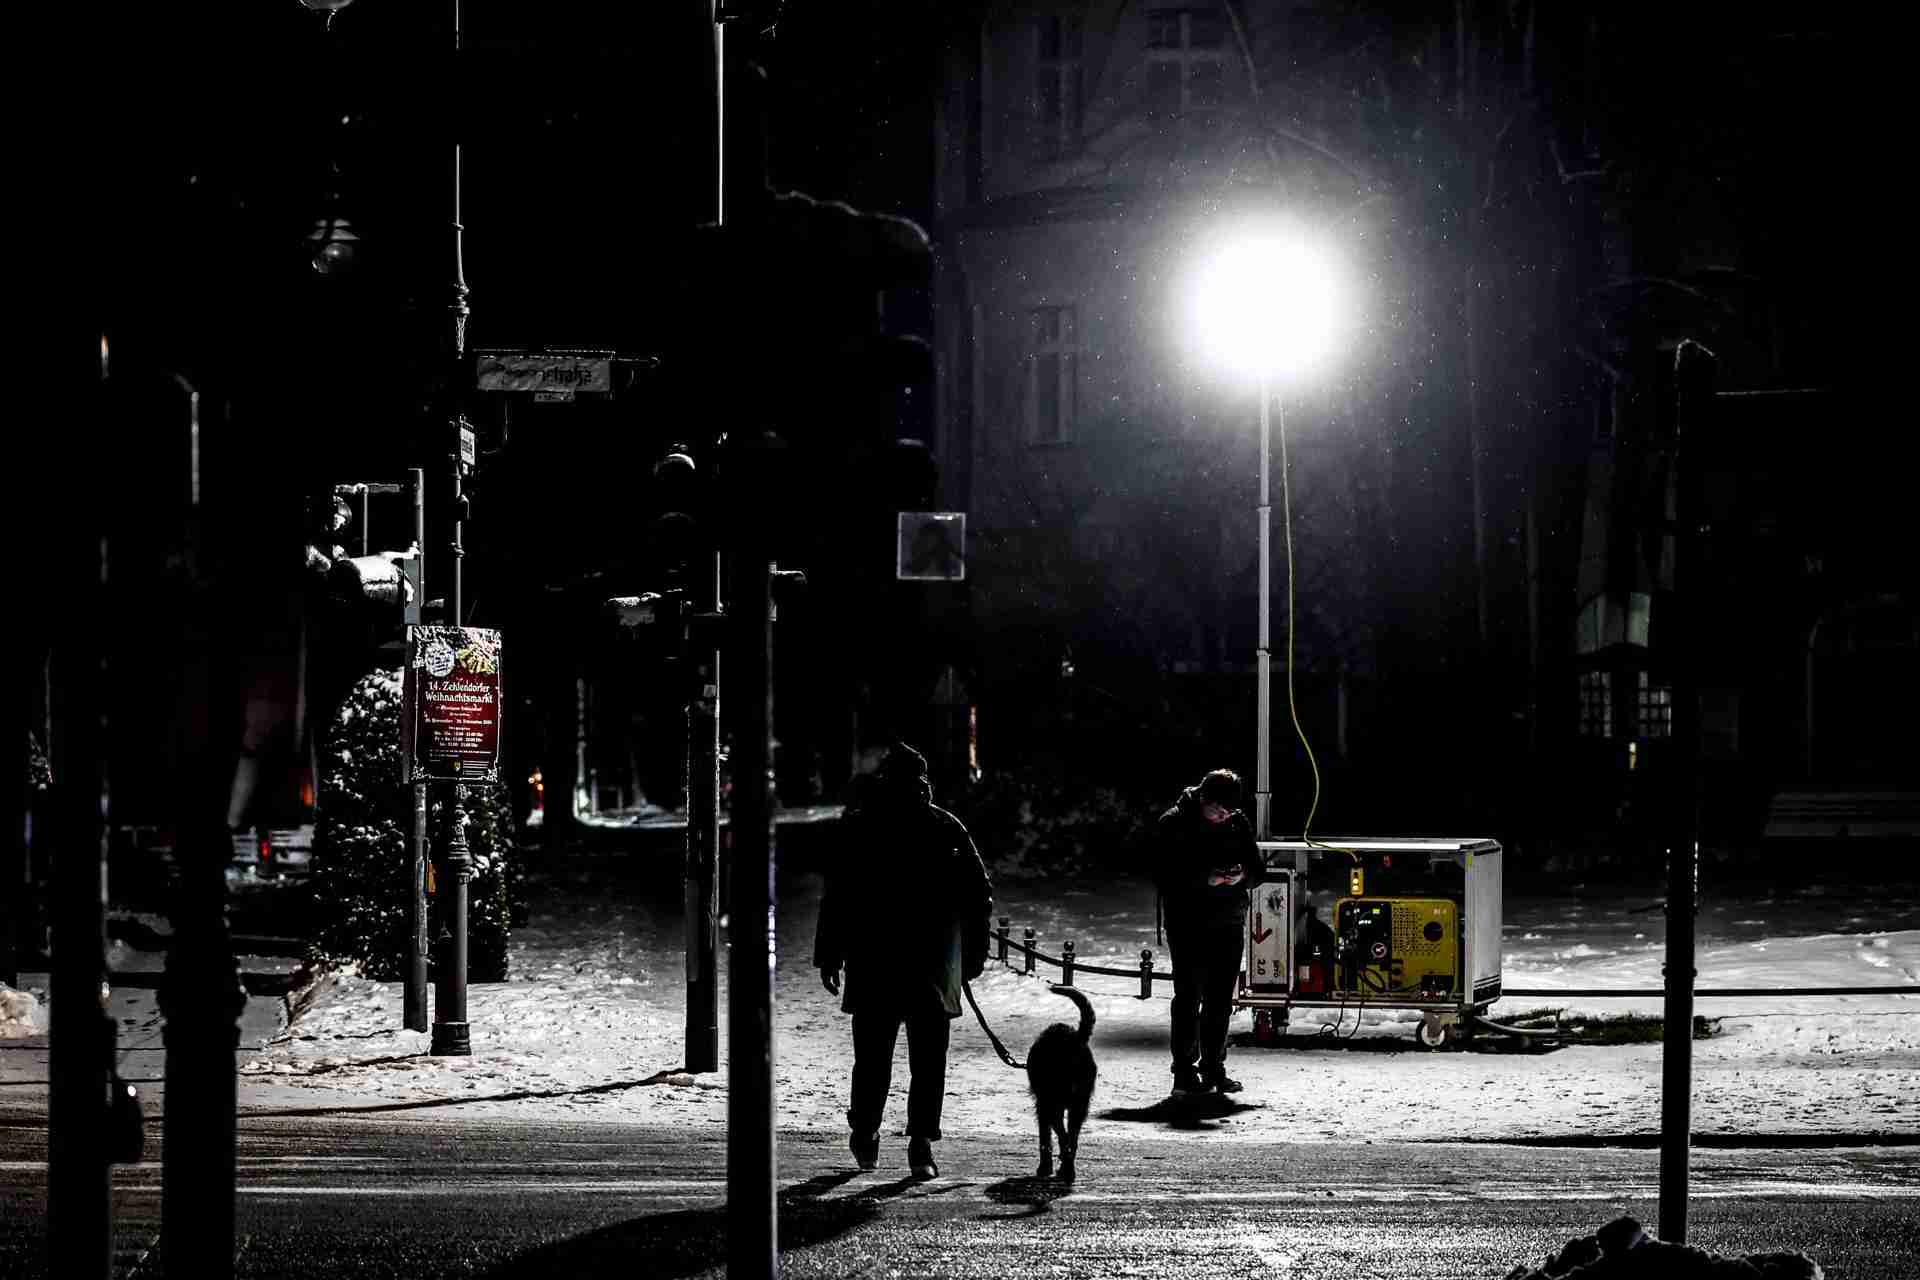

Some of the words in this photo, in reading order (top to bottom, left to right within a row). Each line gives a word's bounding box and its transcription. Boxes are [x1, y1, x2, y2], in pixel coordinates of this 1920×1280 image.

[428, 681, 442, 691] 14.
[442, 681, 490, 693] Zehlendorfer
[425, 690, 493, 703] Weihnachtsmarkt
